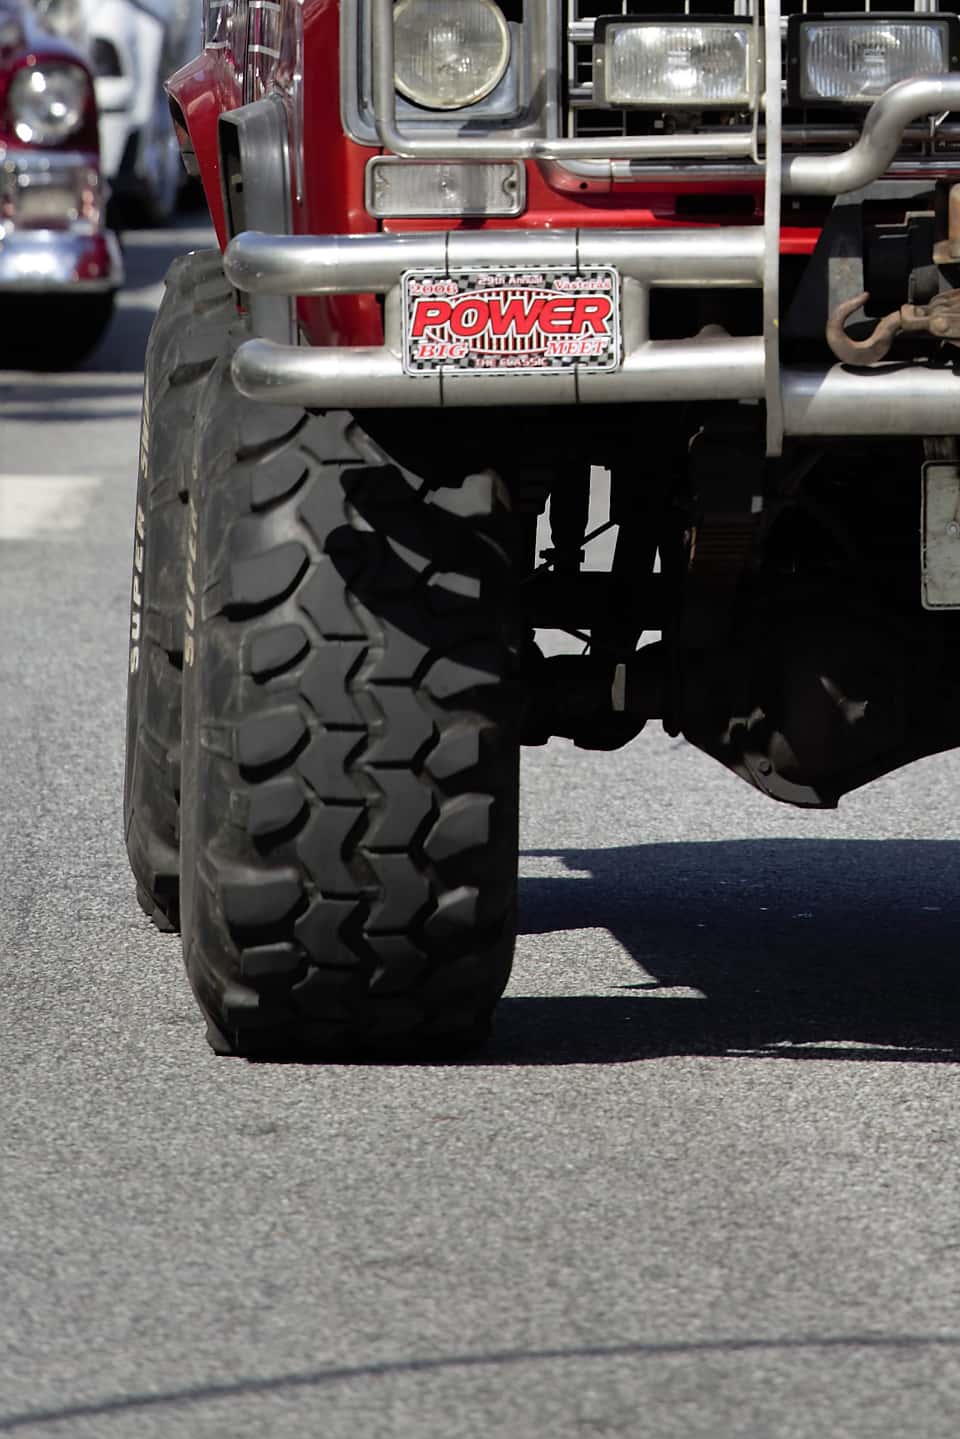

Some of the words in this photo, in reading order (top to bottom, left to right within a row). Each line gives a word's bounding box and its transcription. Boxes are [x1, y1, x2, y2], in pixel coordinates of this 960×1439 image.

[410, 281, 458, 295] 2006
[508, 274, 543, 285] Annual
[411, 297, 612, 337] POWER
[417, 343, 468, 359] BIG
[547, 339, 609, 356] MEET
